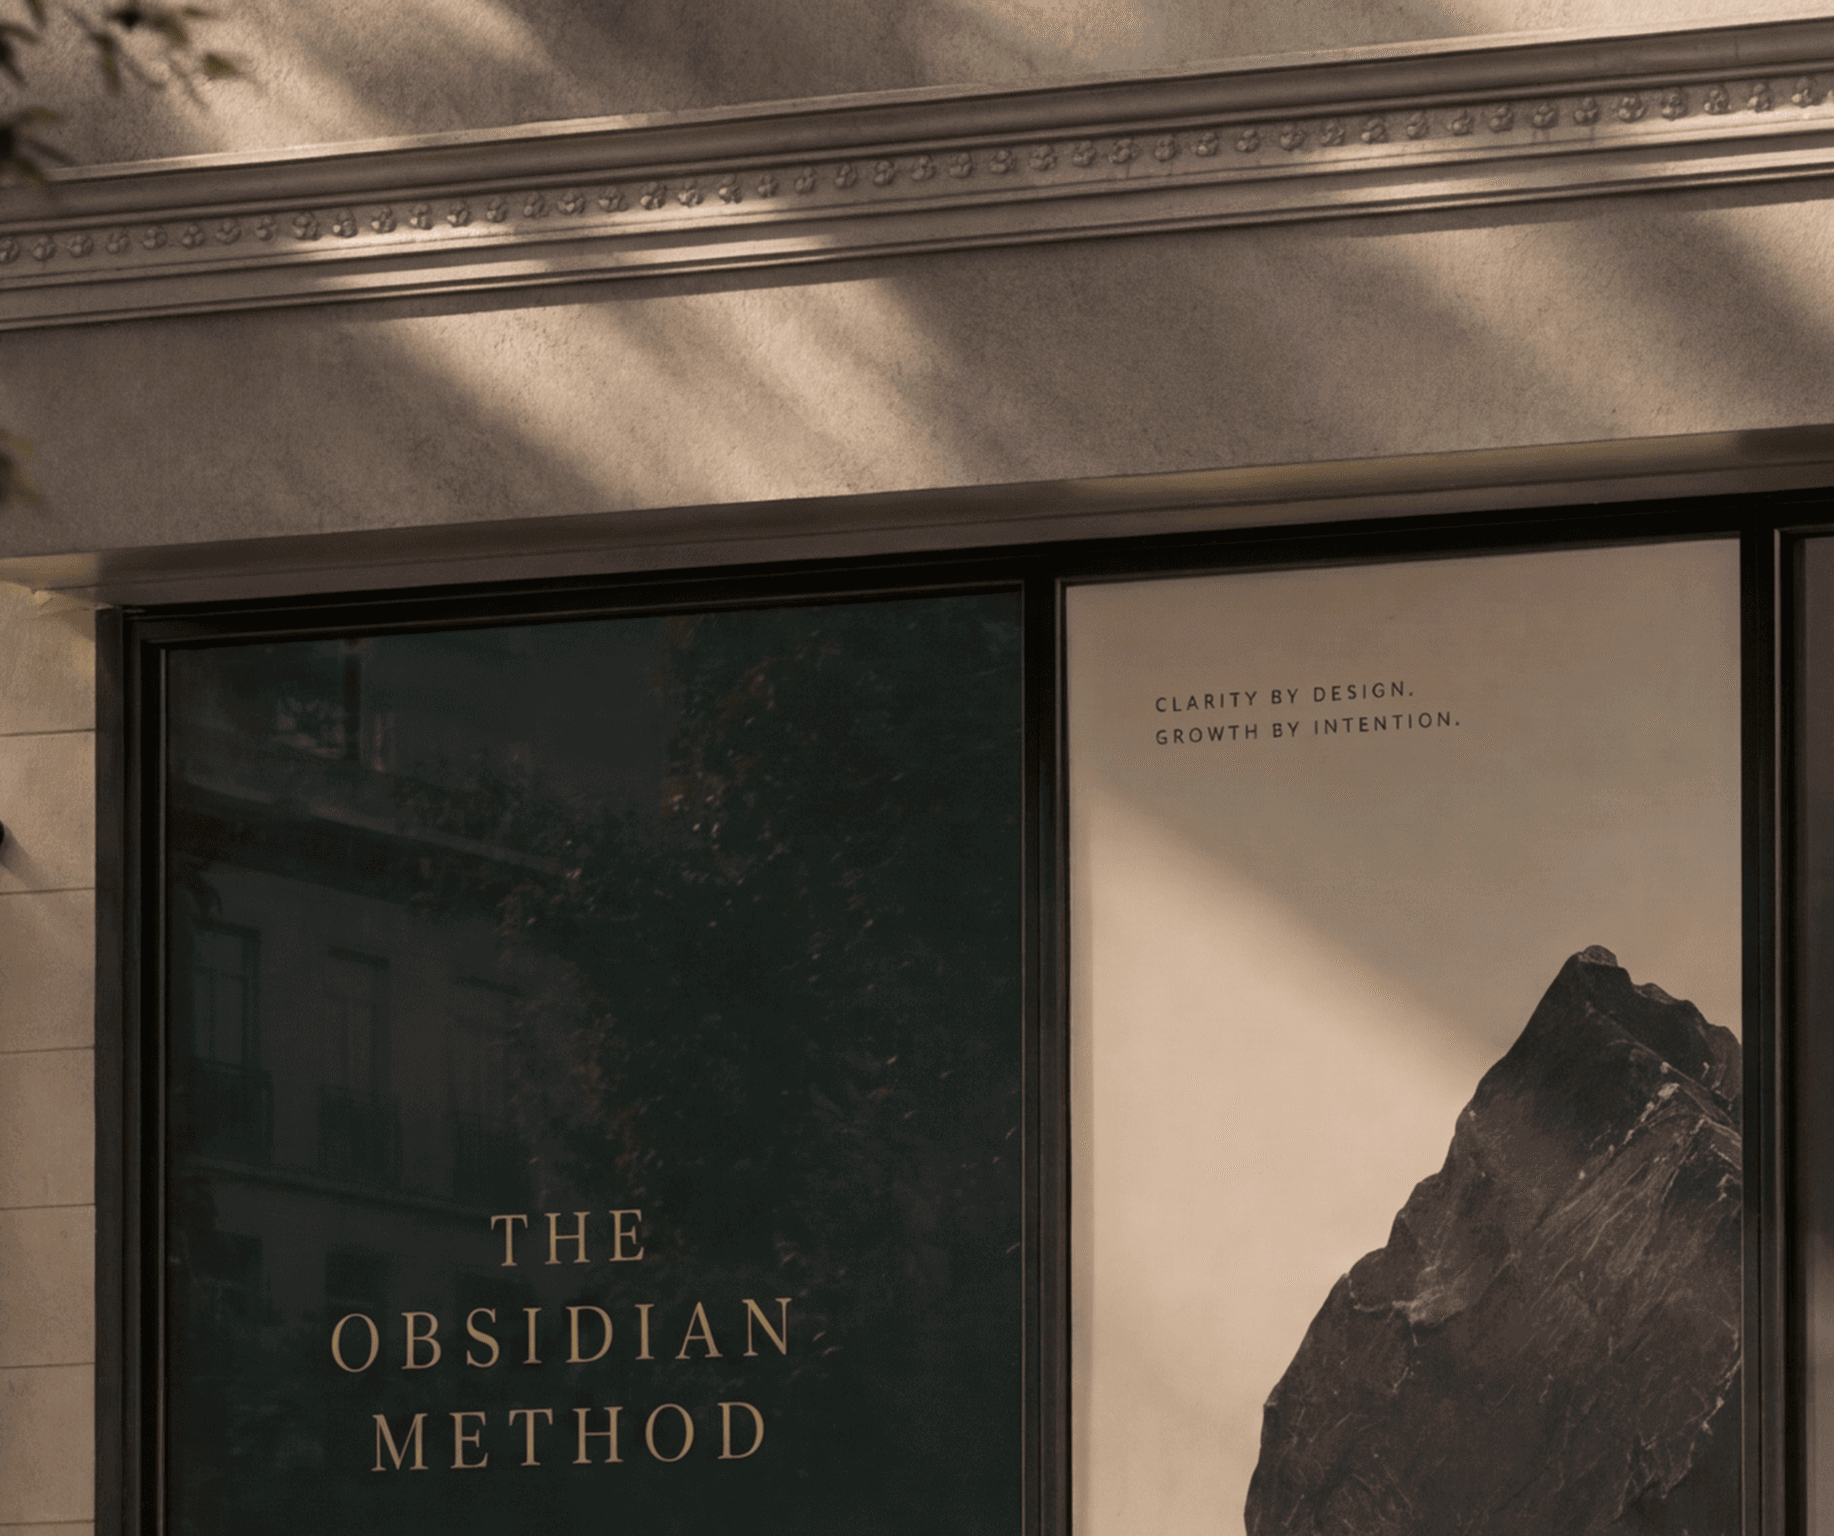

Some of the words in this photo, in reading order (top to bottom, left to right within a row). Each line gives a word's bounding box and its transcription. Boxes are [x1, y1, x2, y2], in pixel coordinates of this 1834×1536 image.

[1156, 690, 1257, 713] CLARITY
[1271, 688, 1299, 705] BY
[1314, 680, 1414, 703] DESIGN.
[1156, 723, 1258, 745] GROWTH
[1272, 721, 1299, 738] BY
[1315, 711, 1460, 735] INTENTION.
[490, 1208, 645, 1267] THE
[331, 1298, 792, 1373] OBSIDIAN
[371, 1401, 765, 1472] METHOD
